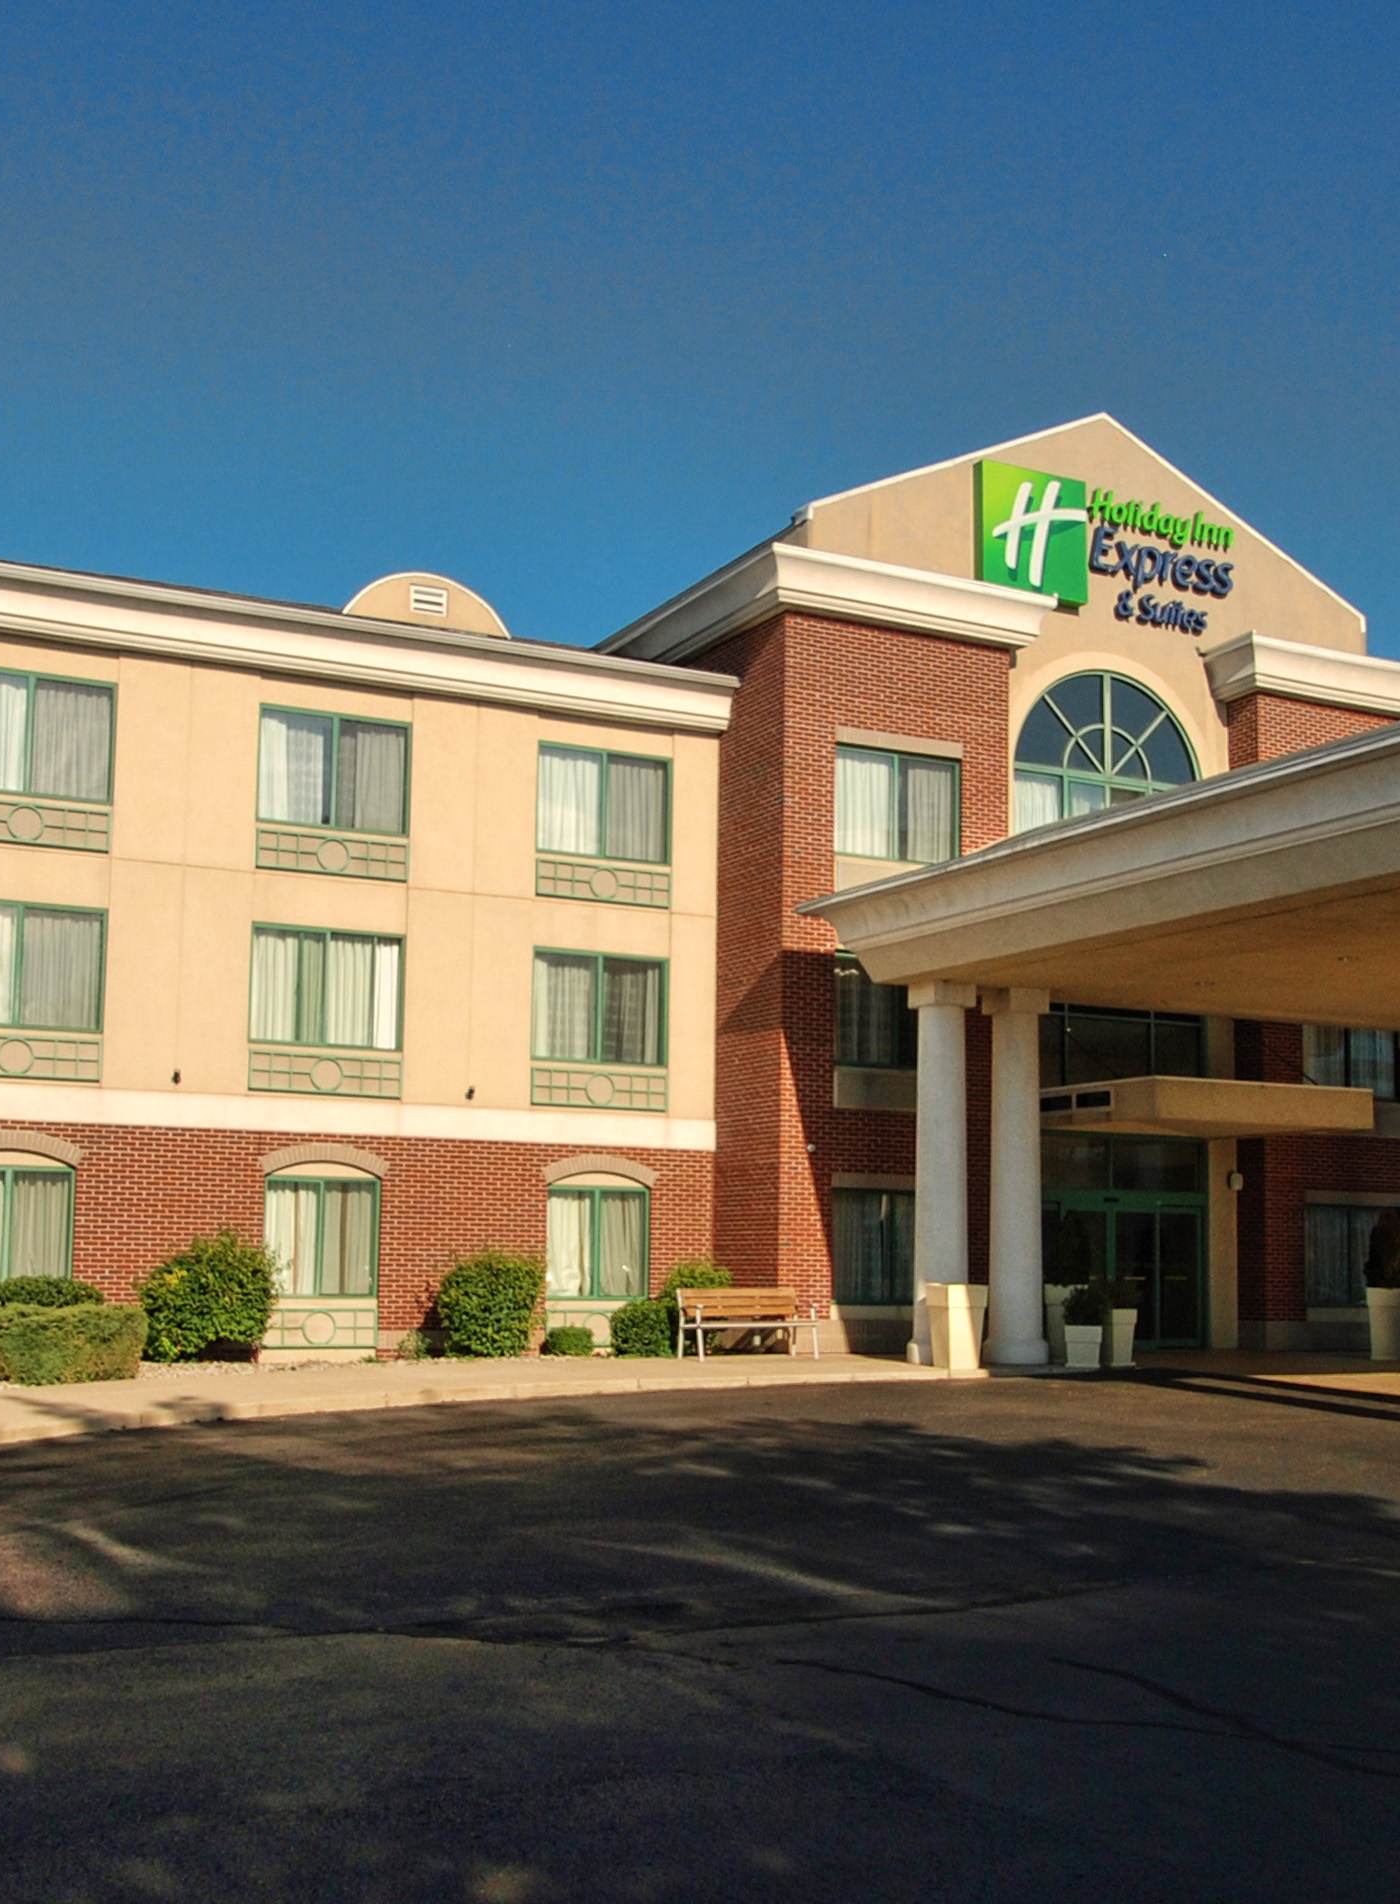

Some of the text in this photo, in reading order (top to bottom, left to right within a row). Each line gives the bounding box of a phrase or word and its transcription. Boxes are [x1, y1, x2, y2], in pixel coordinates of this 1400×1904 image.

[1087, 487, 1235, 550] Holiday Inn
[1089, 525, 1234, 597] Express
[1114, 589, 1209, 634] & Suites
